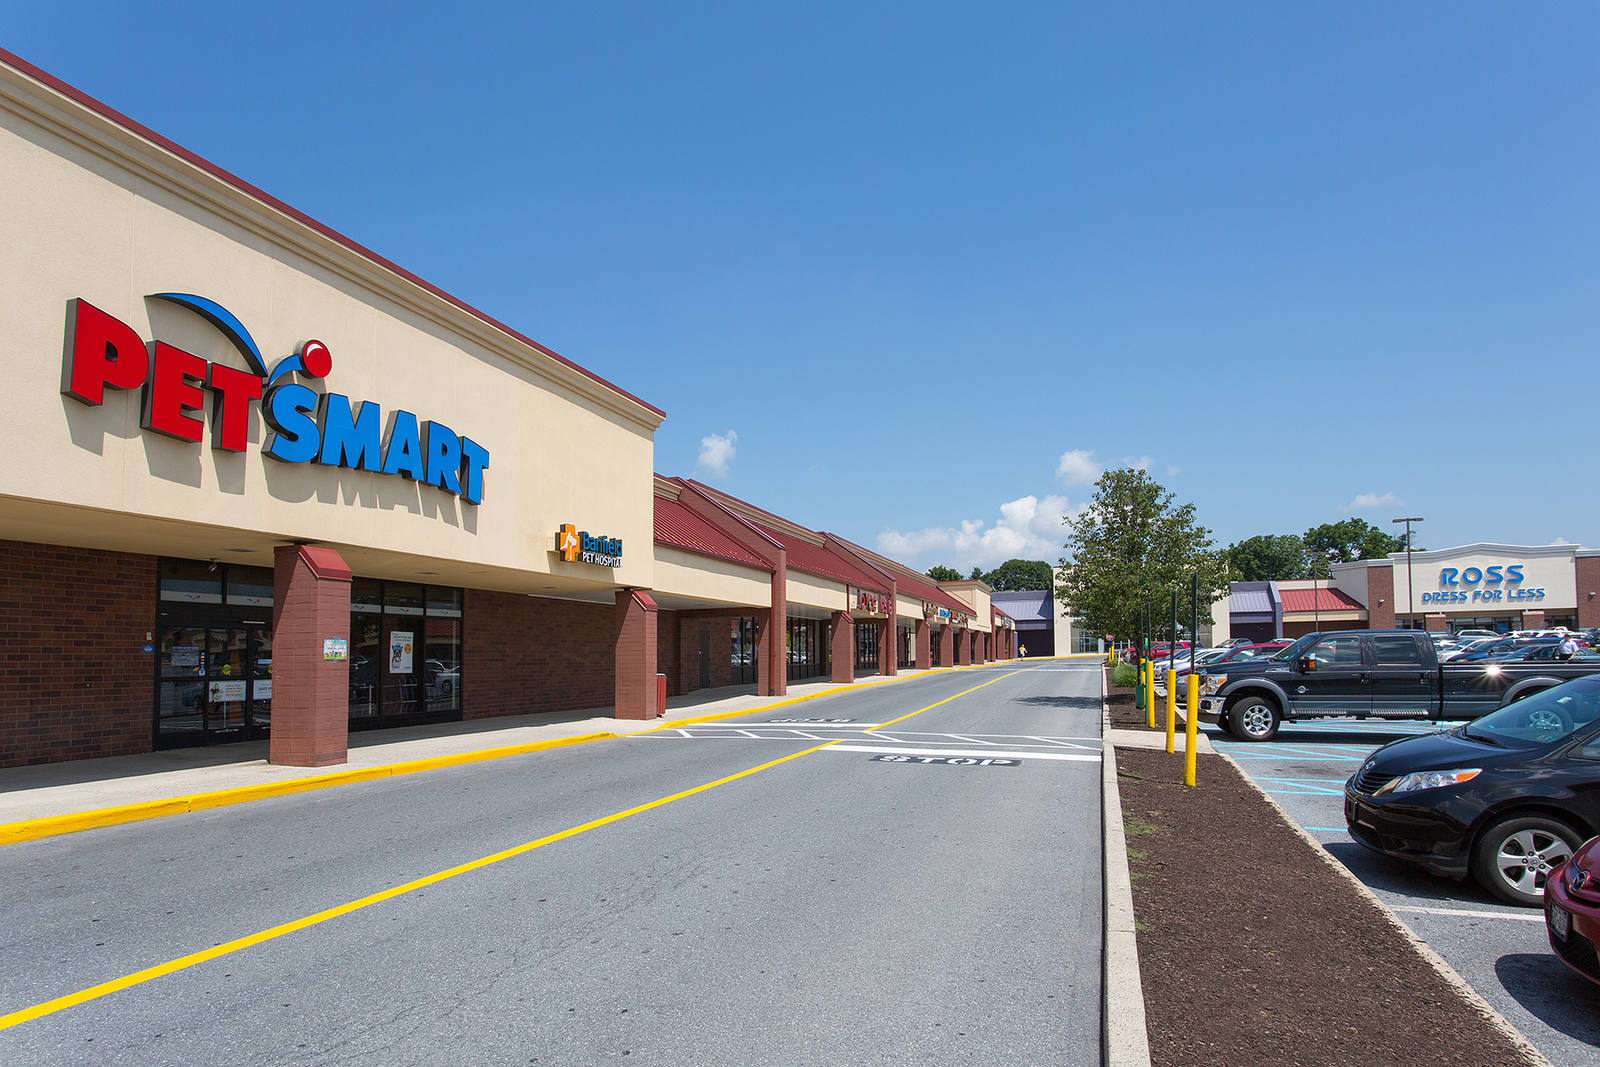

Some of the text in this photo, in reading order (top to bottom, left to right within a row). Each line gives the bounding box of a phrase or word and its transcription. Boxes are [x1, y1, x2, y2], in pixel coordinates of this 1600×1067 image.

[61, 297, 490, 505] PETSMART
[582, 531, 622, 557] Banfield
[582, 552, 594, 563] PET
[1441, 564, 1525, 586] ROSS
[1422, 587, 1546, 602] DRESS FOR LESS
[878, 755, 1014, 766] STOP
